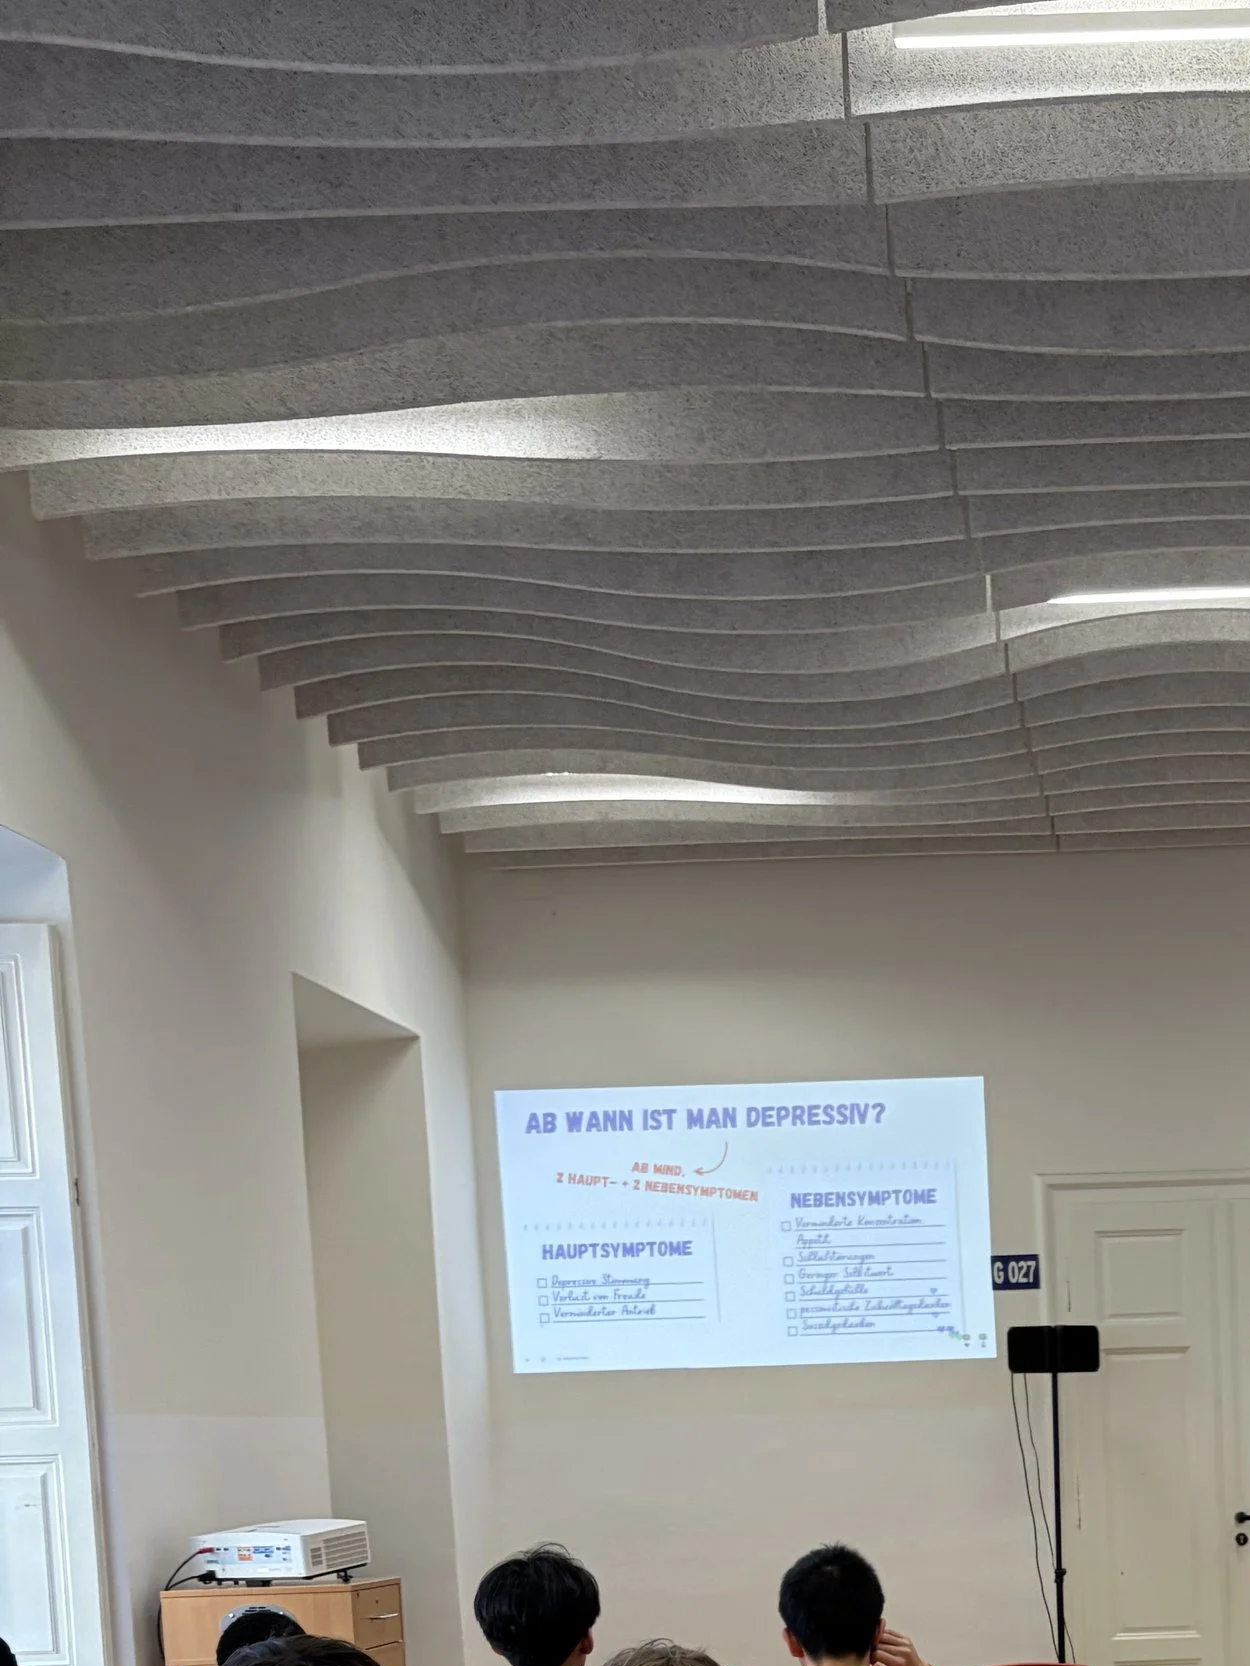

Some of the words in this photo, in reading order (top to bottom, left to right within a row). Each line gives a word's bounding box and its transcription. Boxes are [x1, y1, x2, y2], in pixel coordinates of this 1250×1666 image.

[525, 1112, 557, 1134] AB
[565, 1110, 633, 1133] WANN
[642, 1108, 678, 1131] IST
[687, 1107, 737, 1130] MAN
[746, 1102, 886, 1128] DEPRESSIV?
[631, 1161, 649, 1174] AB
[555, 1172, 564, 1183] 2
[568, 1173, 618, 1188] HAUPT-
[633, 1179, 641, 1190] 2
[645, 1180, 759, 1202] NEBENSYMPTOMEN
[790, 1188, 937, 1208] NEBENSYMPTOME
[541, 1240, 693, 1260] HAUPTSYMPTOME
[993, 1261, 1004, 1283] G
[1008, 1261, 1036, 1283] 027
[552, 1290, 591, 1302] Verlust
[613, 1288, 646, 1300] Freude
[621, 1303, 656, 1316] Antrieb
